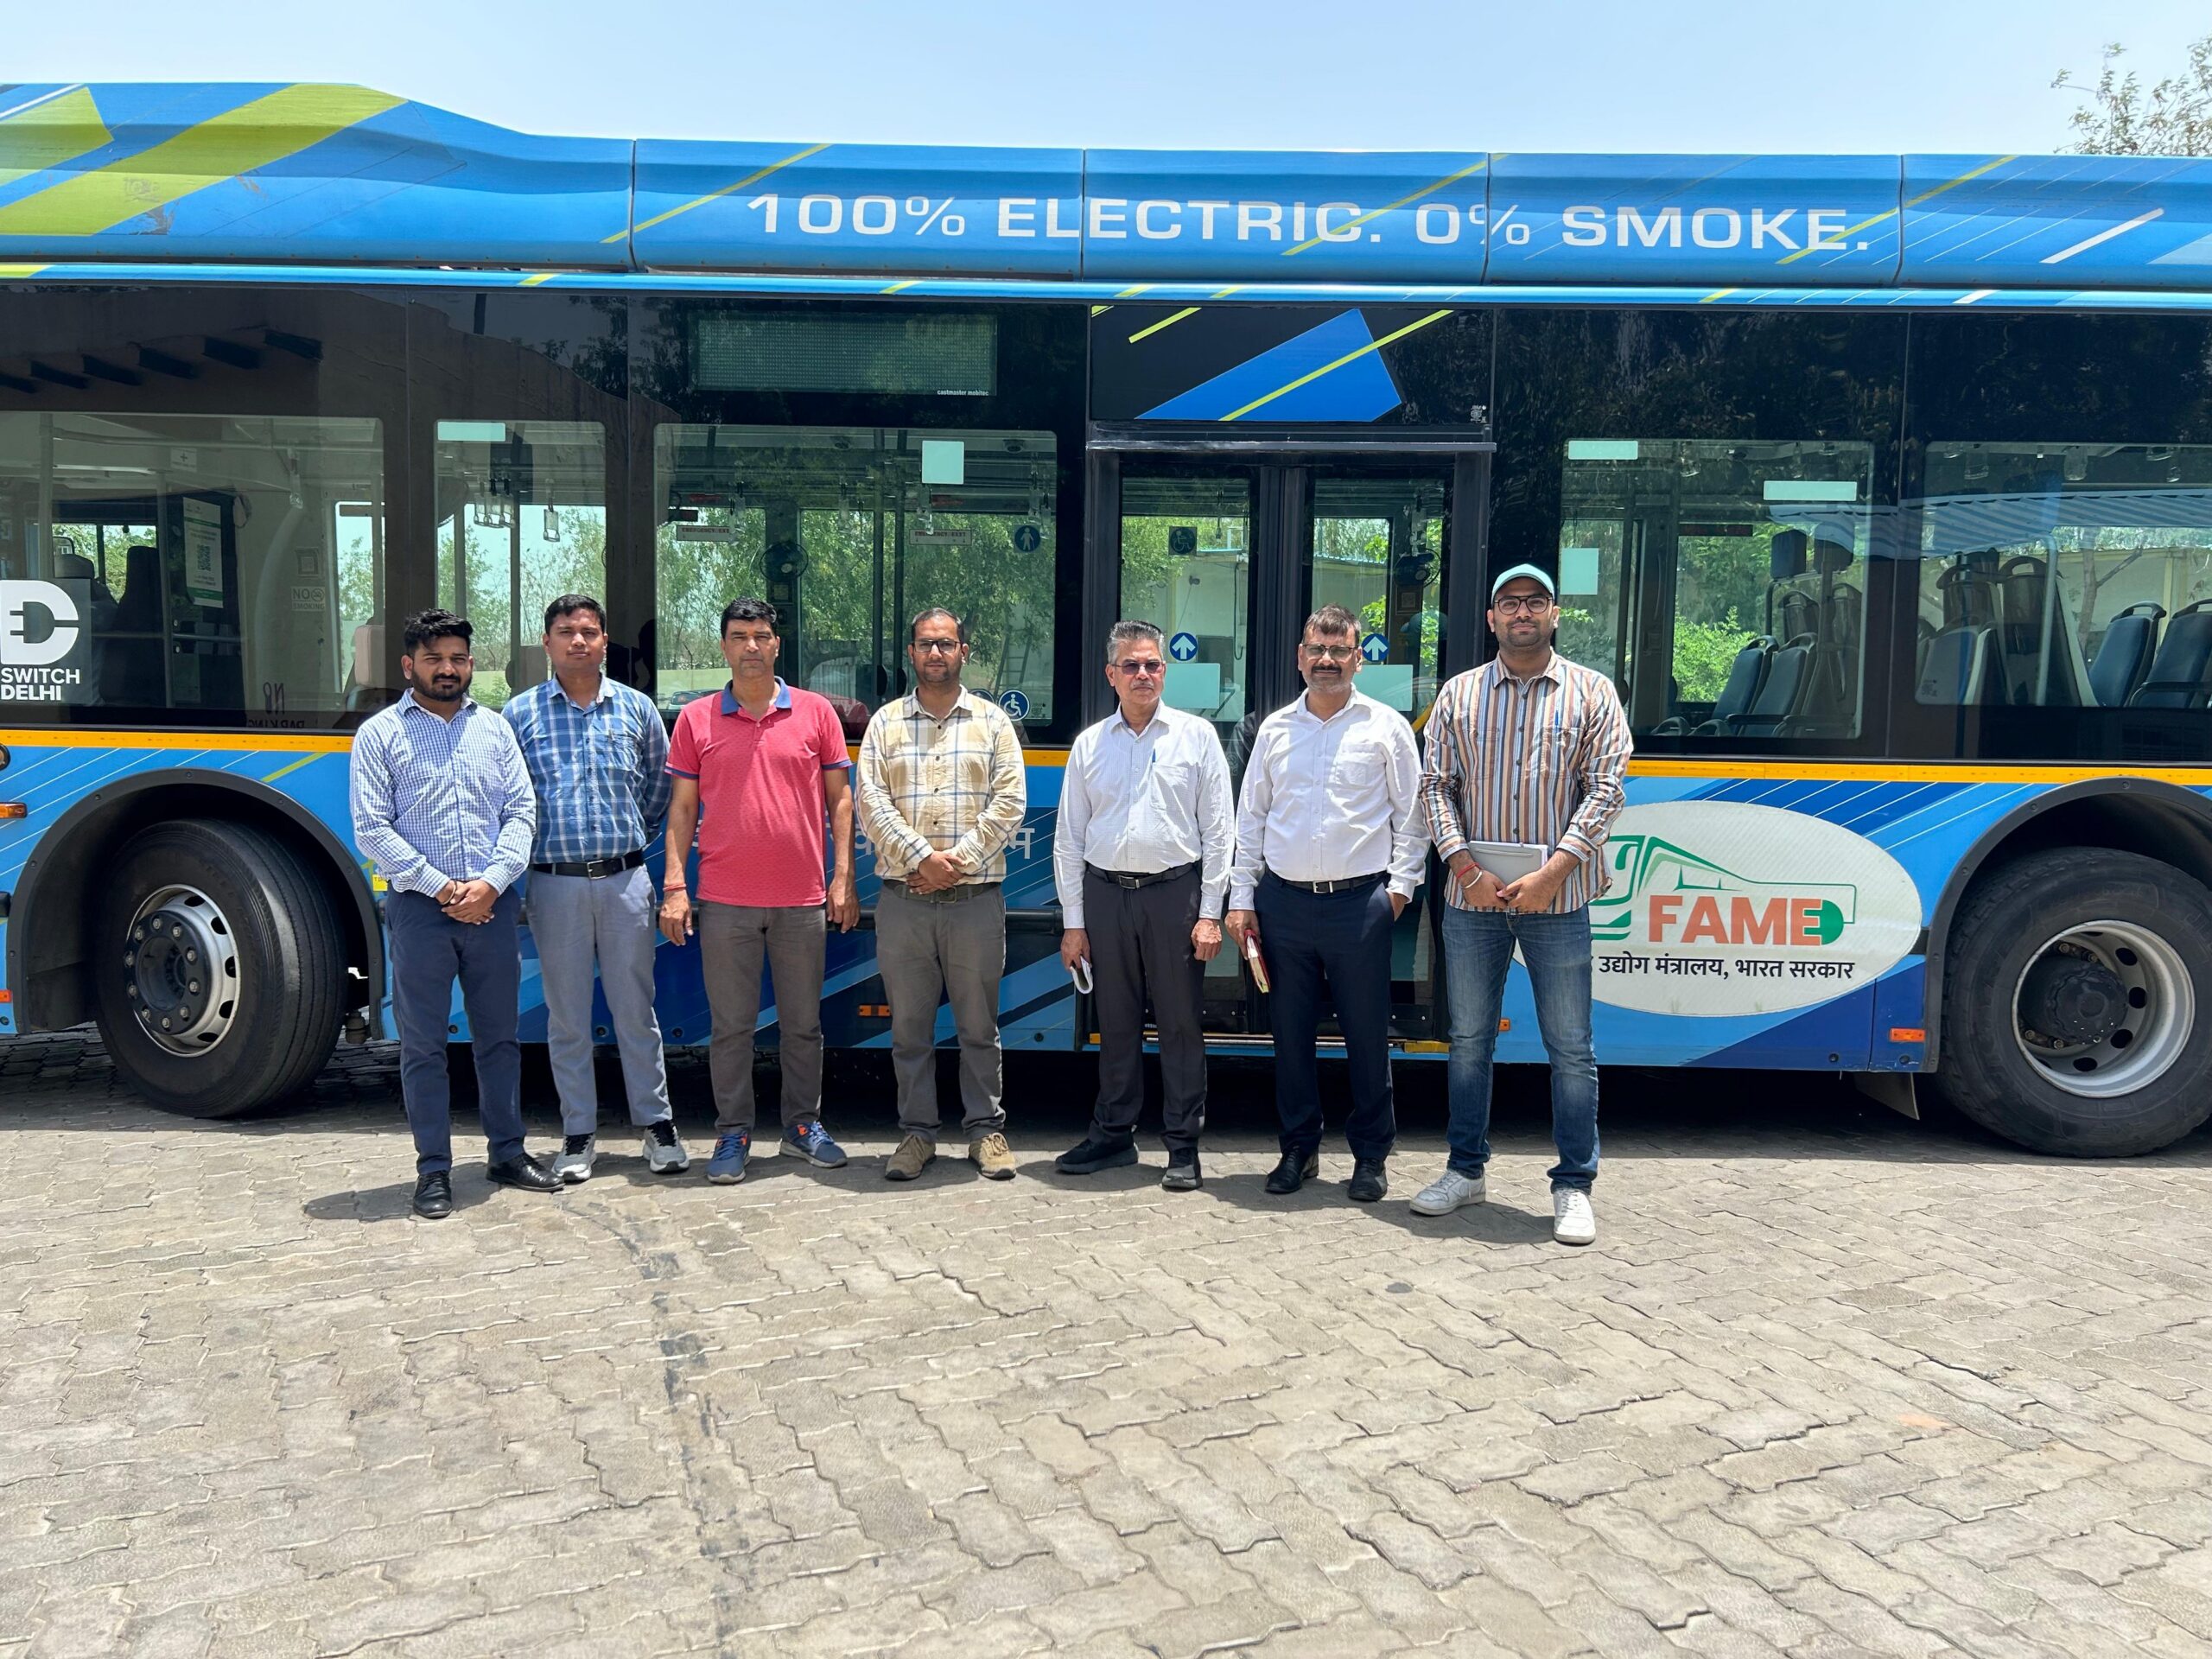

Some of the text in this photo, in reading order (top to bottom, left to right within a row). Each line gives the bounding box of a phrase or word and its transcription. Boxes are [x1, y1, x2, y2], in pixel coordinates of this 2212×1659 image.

[747, 193, 1868, 251] 100% ELECTRIC. 0% SMOKE.
[292, 588, 311, 601] NO
[0, 667, 80, 684] SWITCH
[0, 684, 62, 701] DELHI
[1648, 894, 1823, 946] FAME
[1599, 950, 1650, 975] उद्योग
[1655, 952, 1729, 980] मंत्रालय,
[1734, 958, 1784, 978] भारत
[1789, 960, 1855, 980] सरकार
